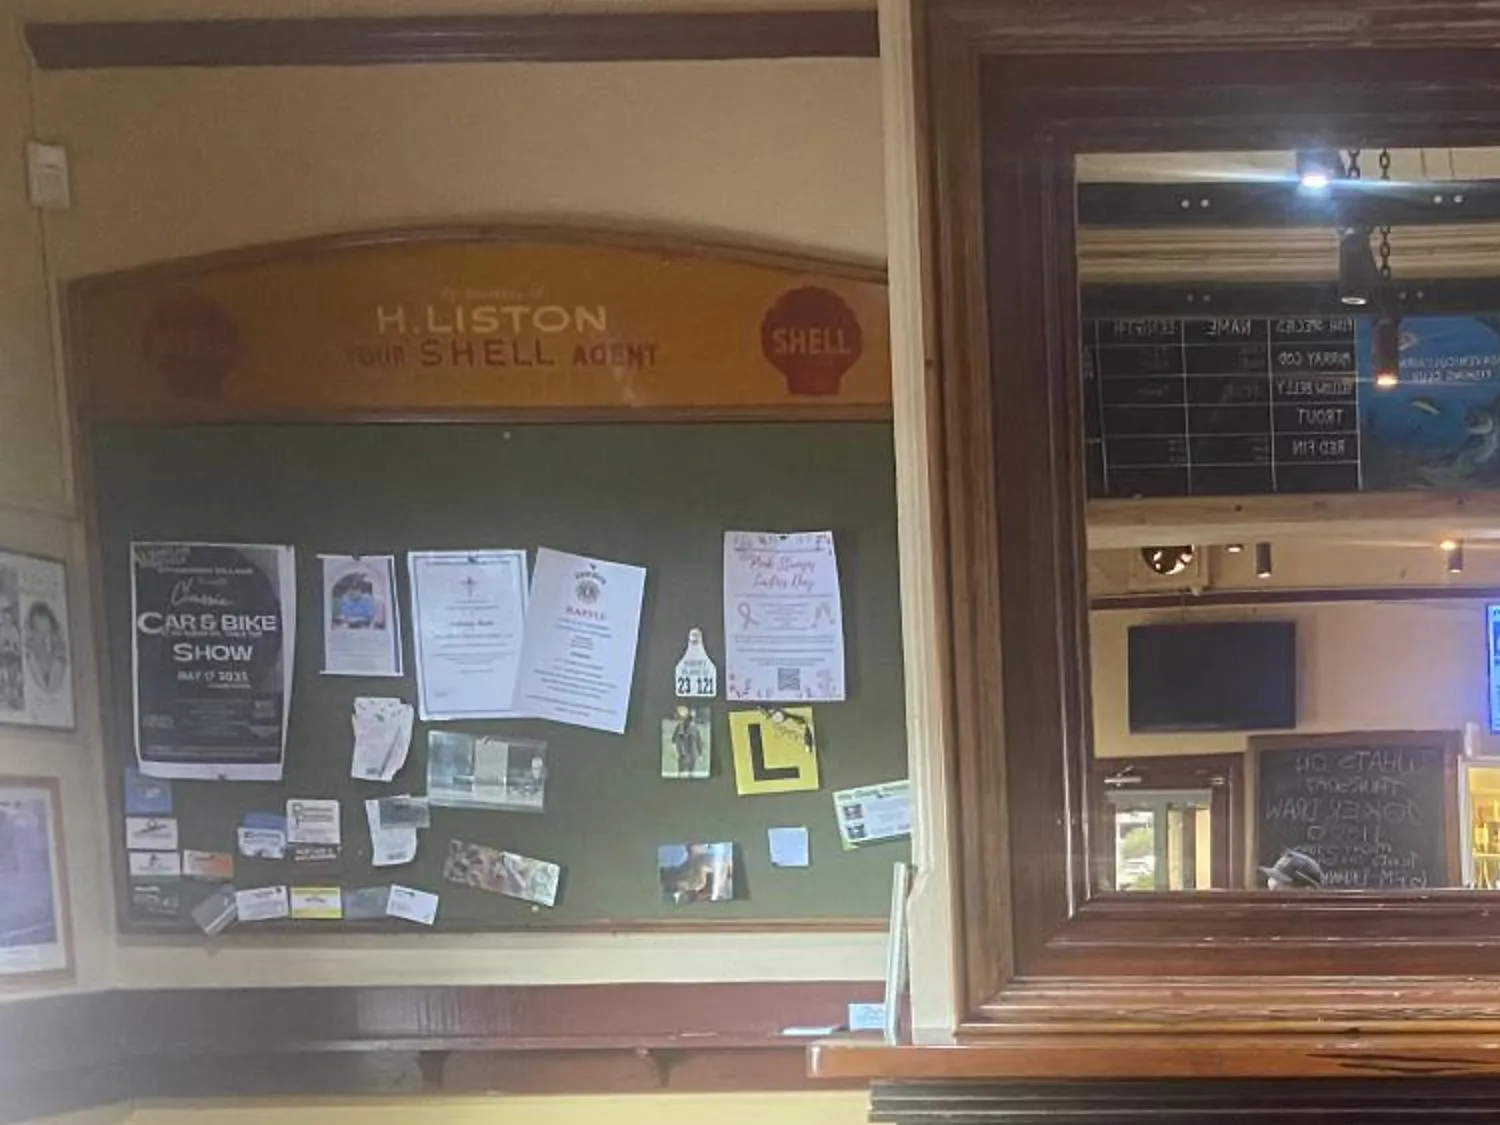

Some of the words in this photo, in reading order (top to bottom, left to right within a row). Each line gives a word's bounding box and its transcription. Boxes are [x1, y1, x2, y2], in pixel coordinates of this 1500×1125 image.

[419, 338, 556, 367] SHELL
[572, 342, 659, 370] AGENT
[772, 326, 852, 355] SHELL
[137, 611, 196, 635] CAR
[221, 613, 278, 632] BIKE
[173, 642, 253, 662] SHOW
[747, 723, 800, 782] L
